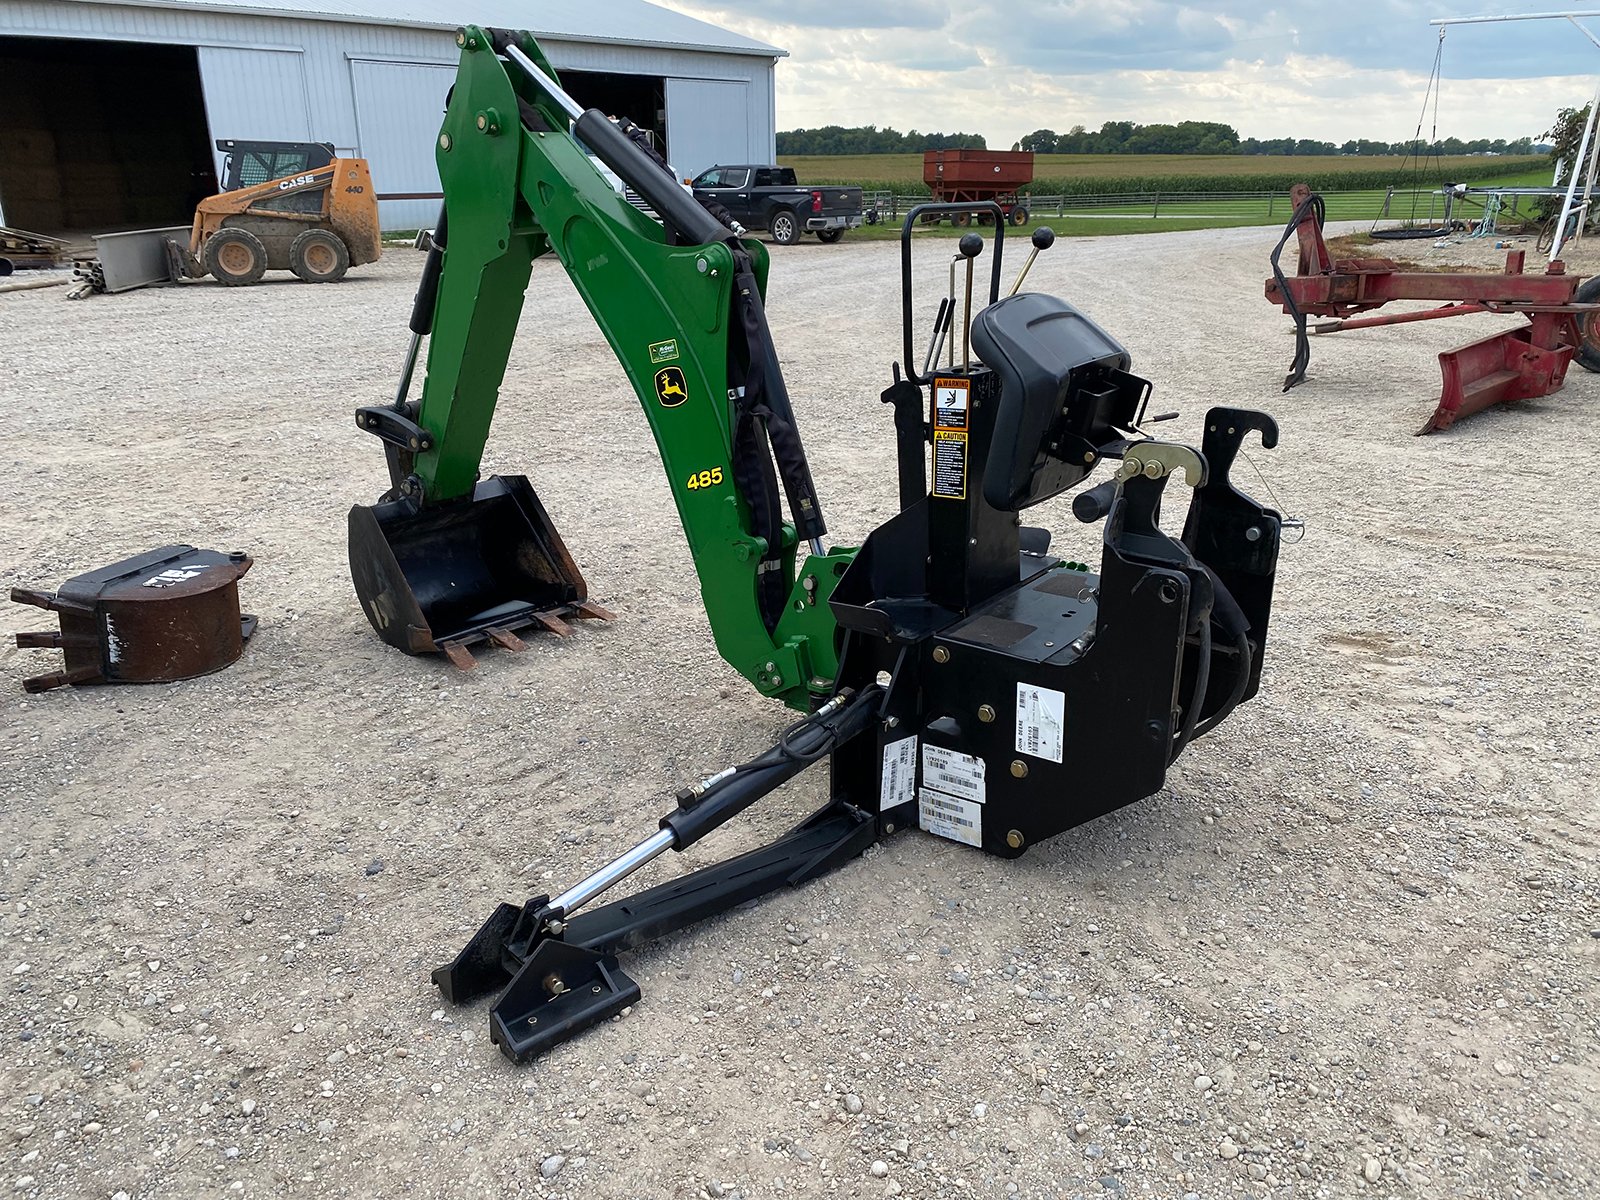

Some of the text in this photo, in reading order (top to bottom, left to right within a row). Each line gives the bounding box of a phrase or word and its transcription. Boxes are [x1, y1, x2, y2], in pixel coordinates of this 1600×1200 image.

[279, 174, 315, 190] CASE
[345, 185, 364, 194] 440
[942, 380, 969, 388] WARNING
[942, 432, 967, 441] CAUTION
[687, 466, 723, 491] 485
